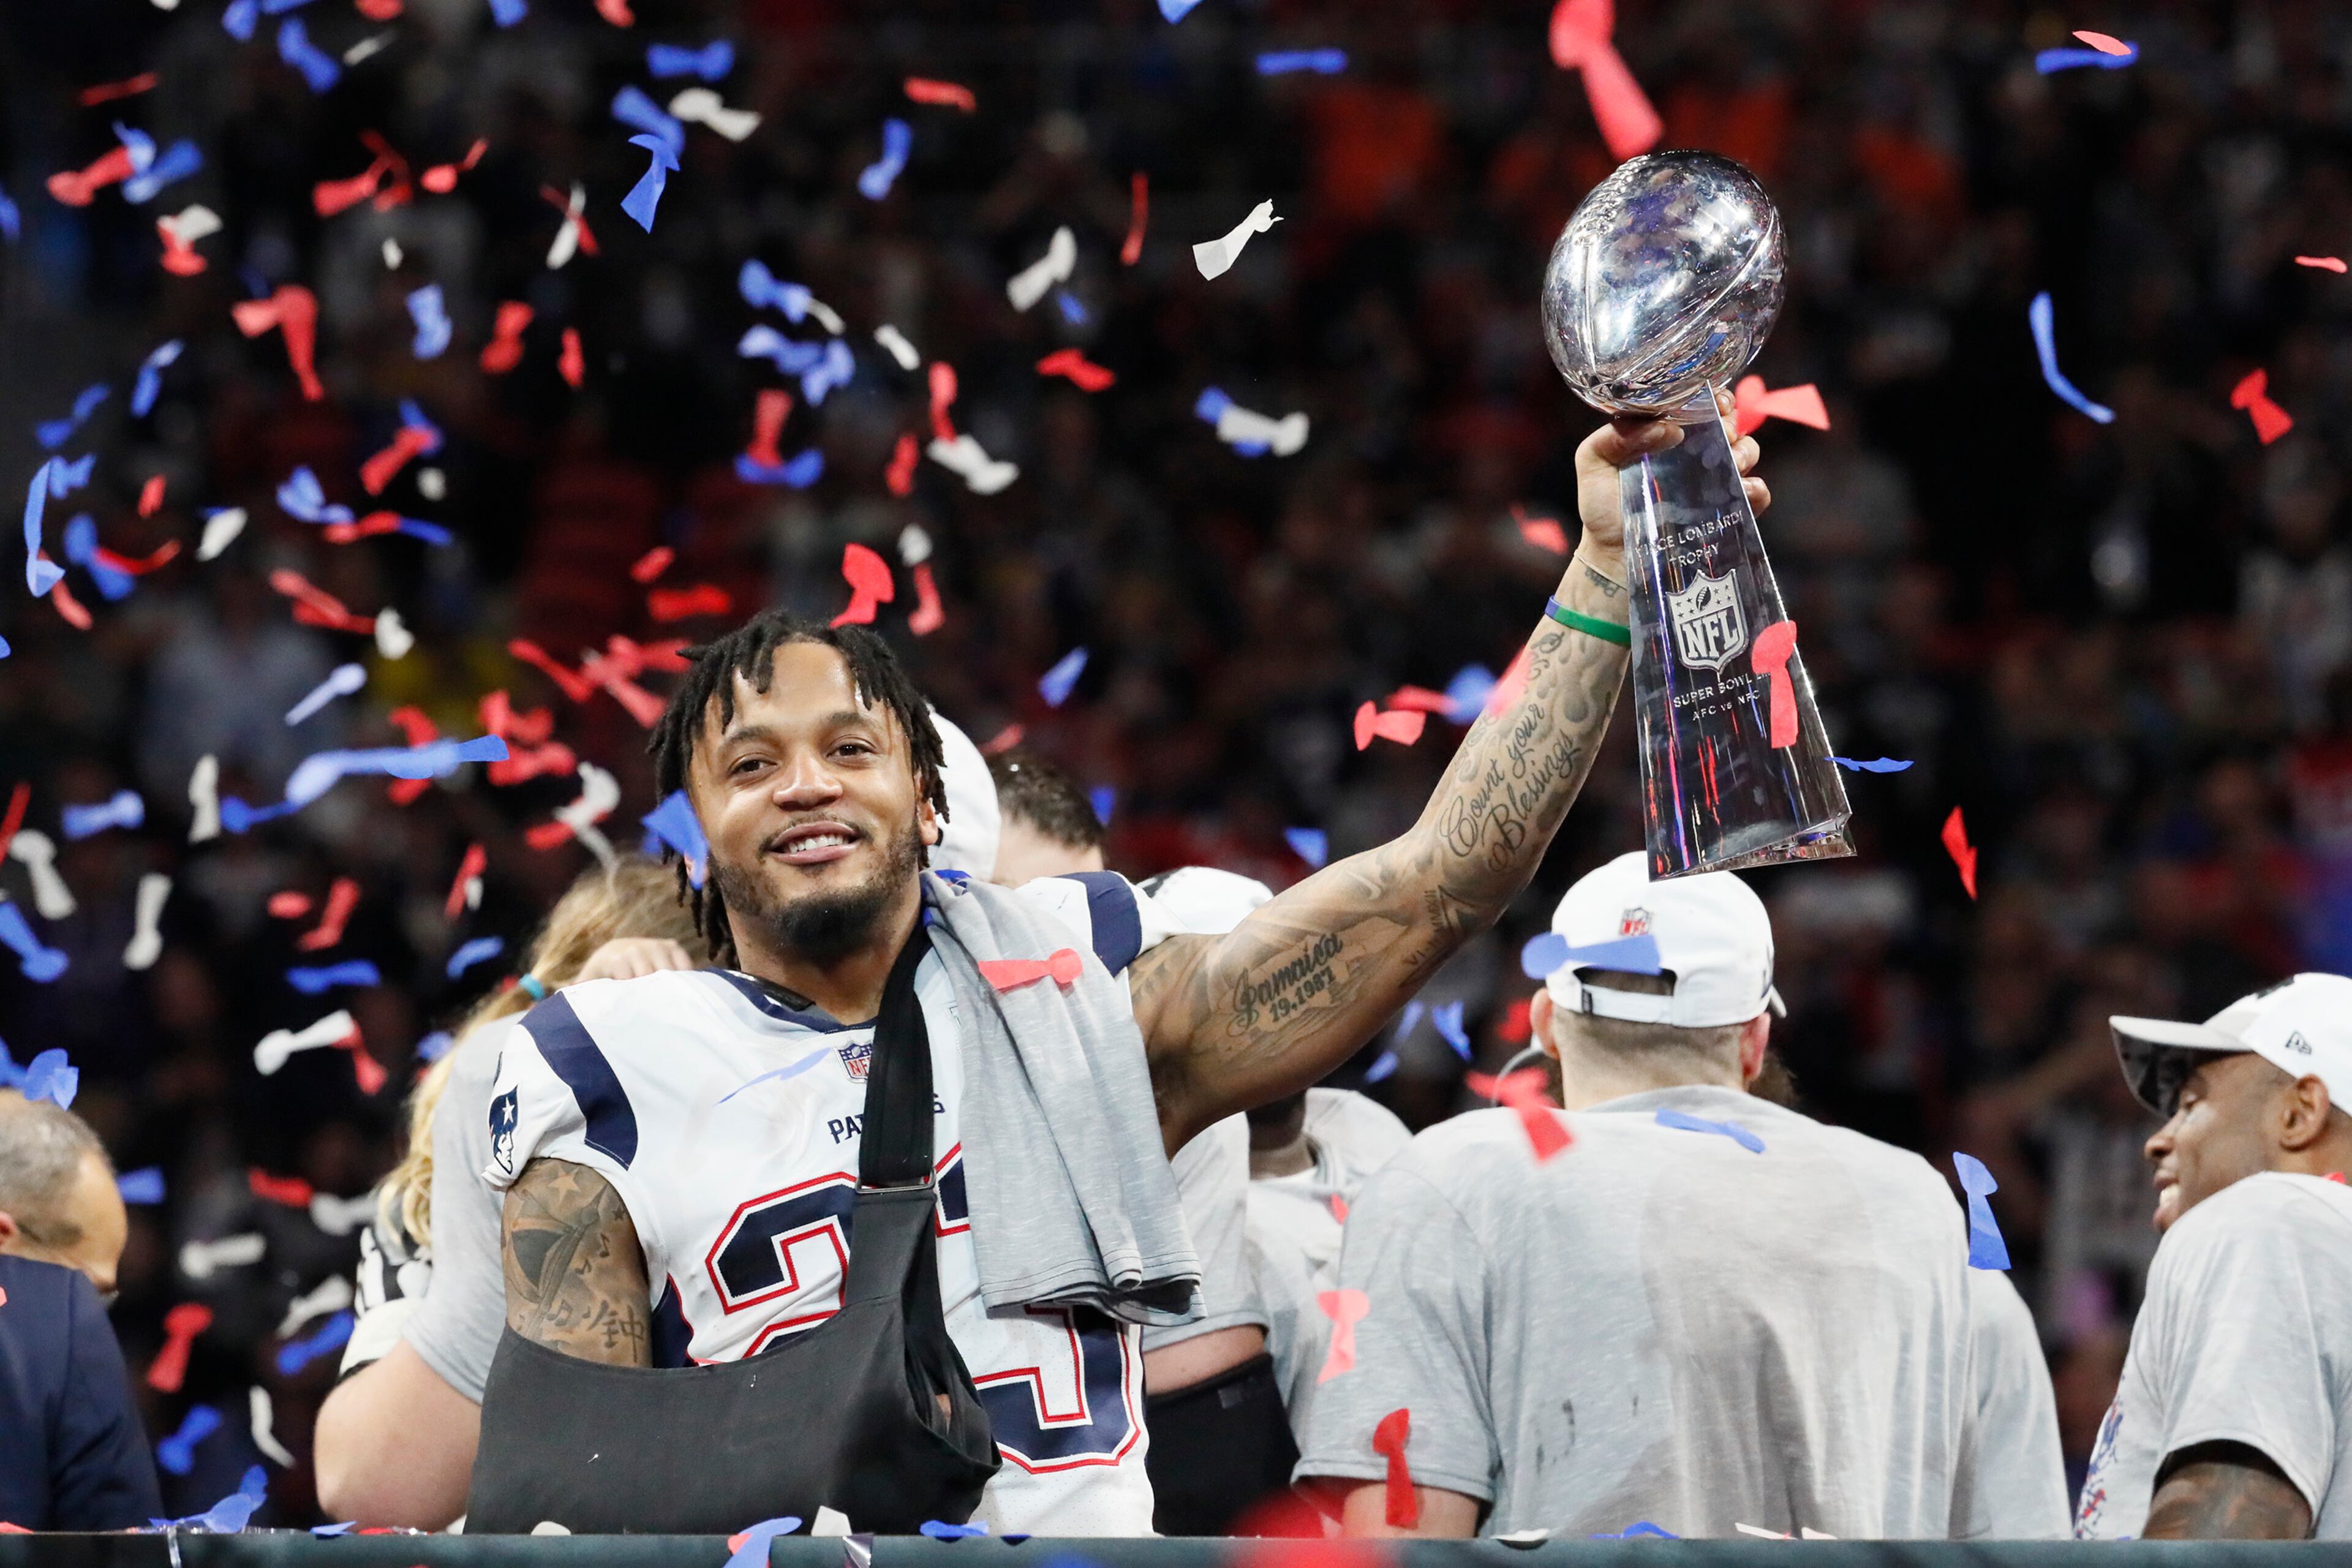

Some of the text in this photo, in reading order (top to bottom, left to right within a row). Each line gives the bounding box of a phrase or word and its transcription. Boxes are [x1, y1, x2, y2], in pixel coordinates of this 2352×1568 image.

[1678, 510, 1744, 544] LOMBARDI
[1669, 543, 1720, 568] TROPHY
[1682, 609, 1738, 658] NFL
[1673, 673, 1752, 708] SUPER BOWL
[1692, 705, 1717, 721] AFC
[1737, 690, 1760, 705] NFC
[1439, 703, 1545, 858] Count your
[1481, 729, 1582, 873] Blessings
[1226, 932, 1343, 1038] Jamaica
[847, 1058, 870, 1076] NF
